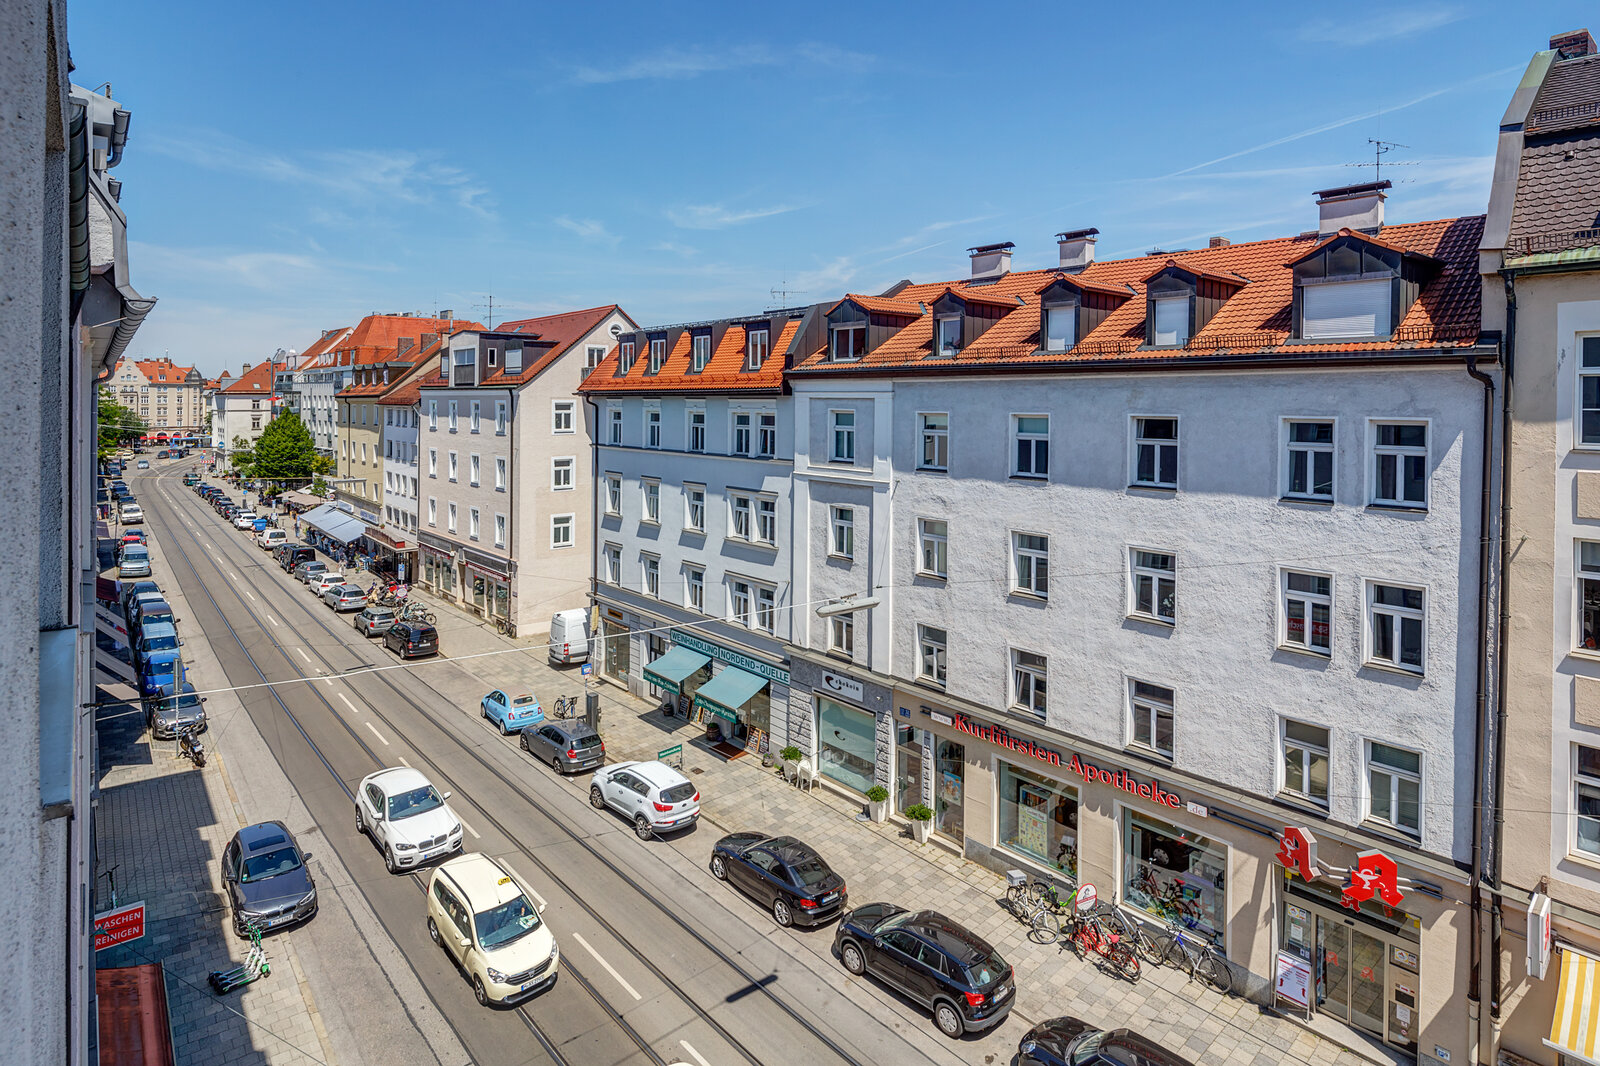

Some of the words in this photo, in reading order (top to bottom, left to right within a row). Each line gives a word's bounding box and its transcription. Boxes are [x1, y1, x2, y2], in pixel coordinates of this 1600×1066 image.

[671, 631, 718, 656] WEINHANDLUNG
[720, 649, 789, 683] NORDEND-QUELLE
[1067, 754, 1180, 810] Apotheke
[95, 926, 140, 946] REINIGEN
